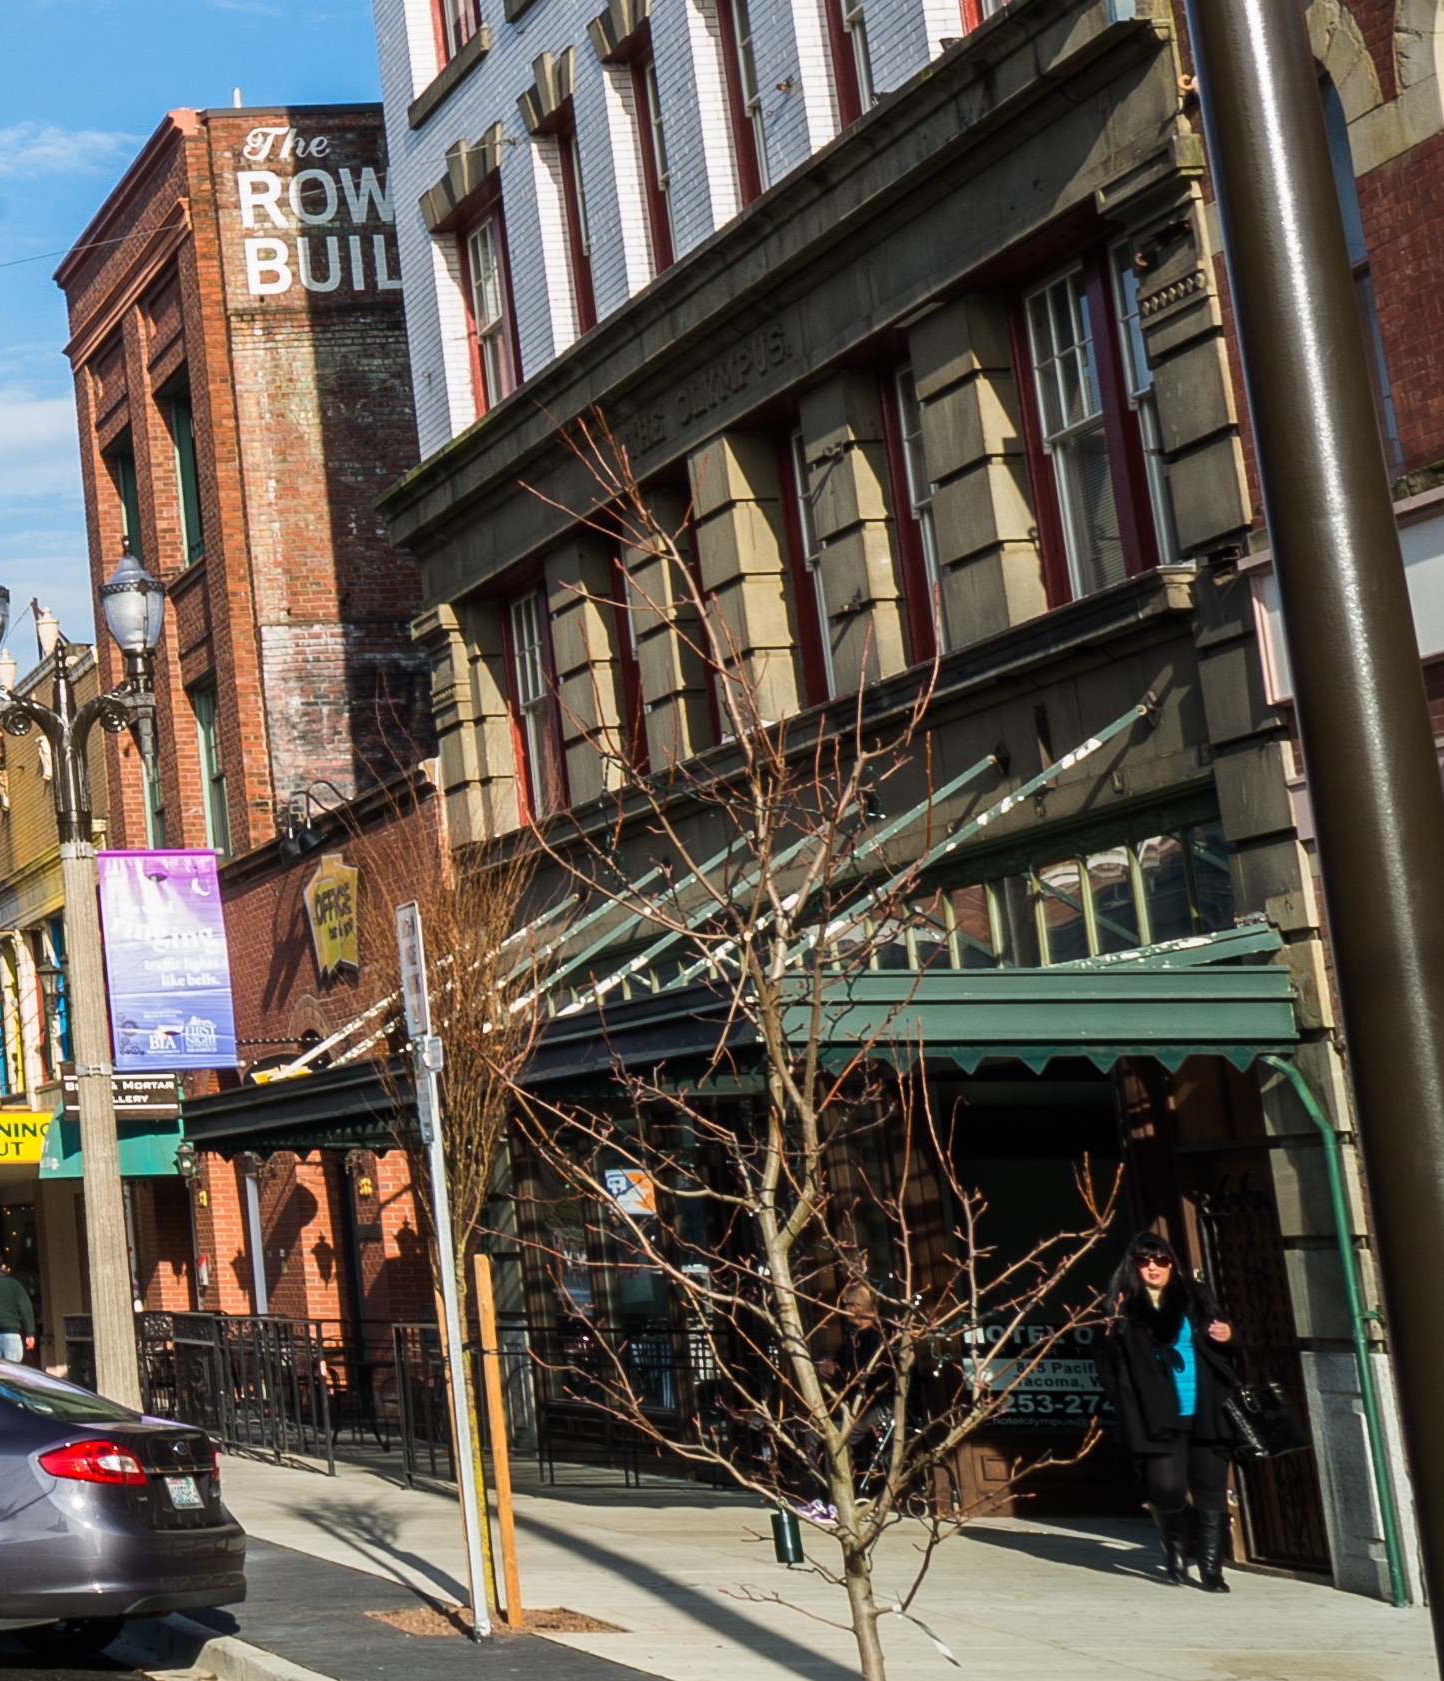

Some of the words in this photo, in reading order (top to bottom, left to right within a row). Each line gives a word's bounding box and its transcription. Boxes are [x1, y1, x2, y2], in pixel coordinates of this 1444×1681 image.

[243, 126, 330, 161] The
[161, 972, 185, 987] like
[149, 1035, 177, 1050] BIA
[112, 1094, 149, 1103] LLERY
[963, 1325, 1065, 1344] HOTEL
[1017, 1362, 1045, 1373] 85
